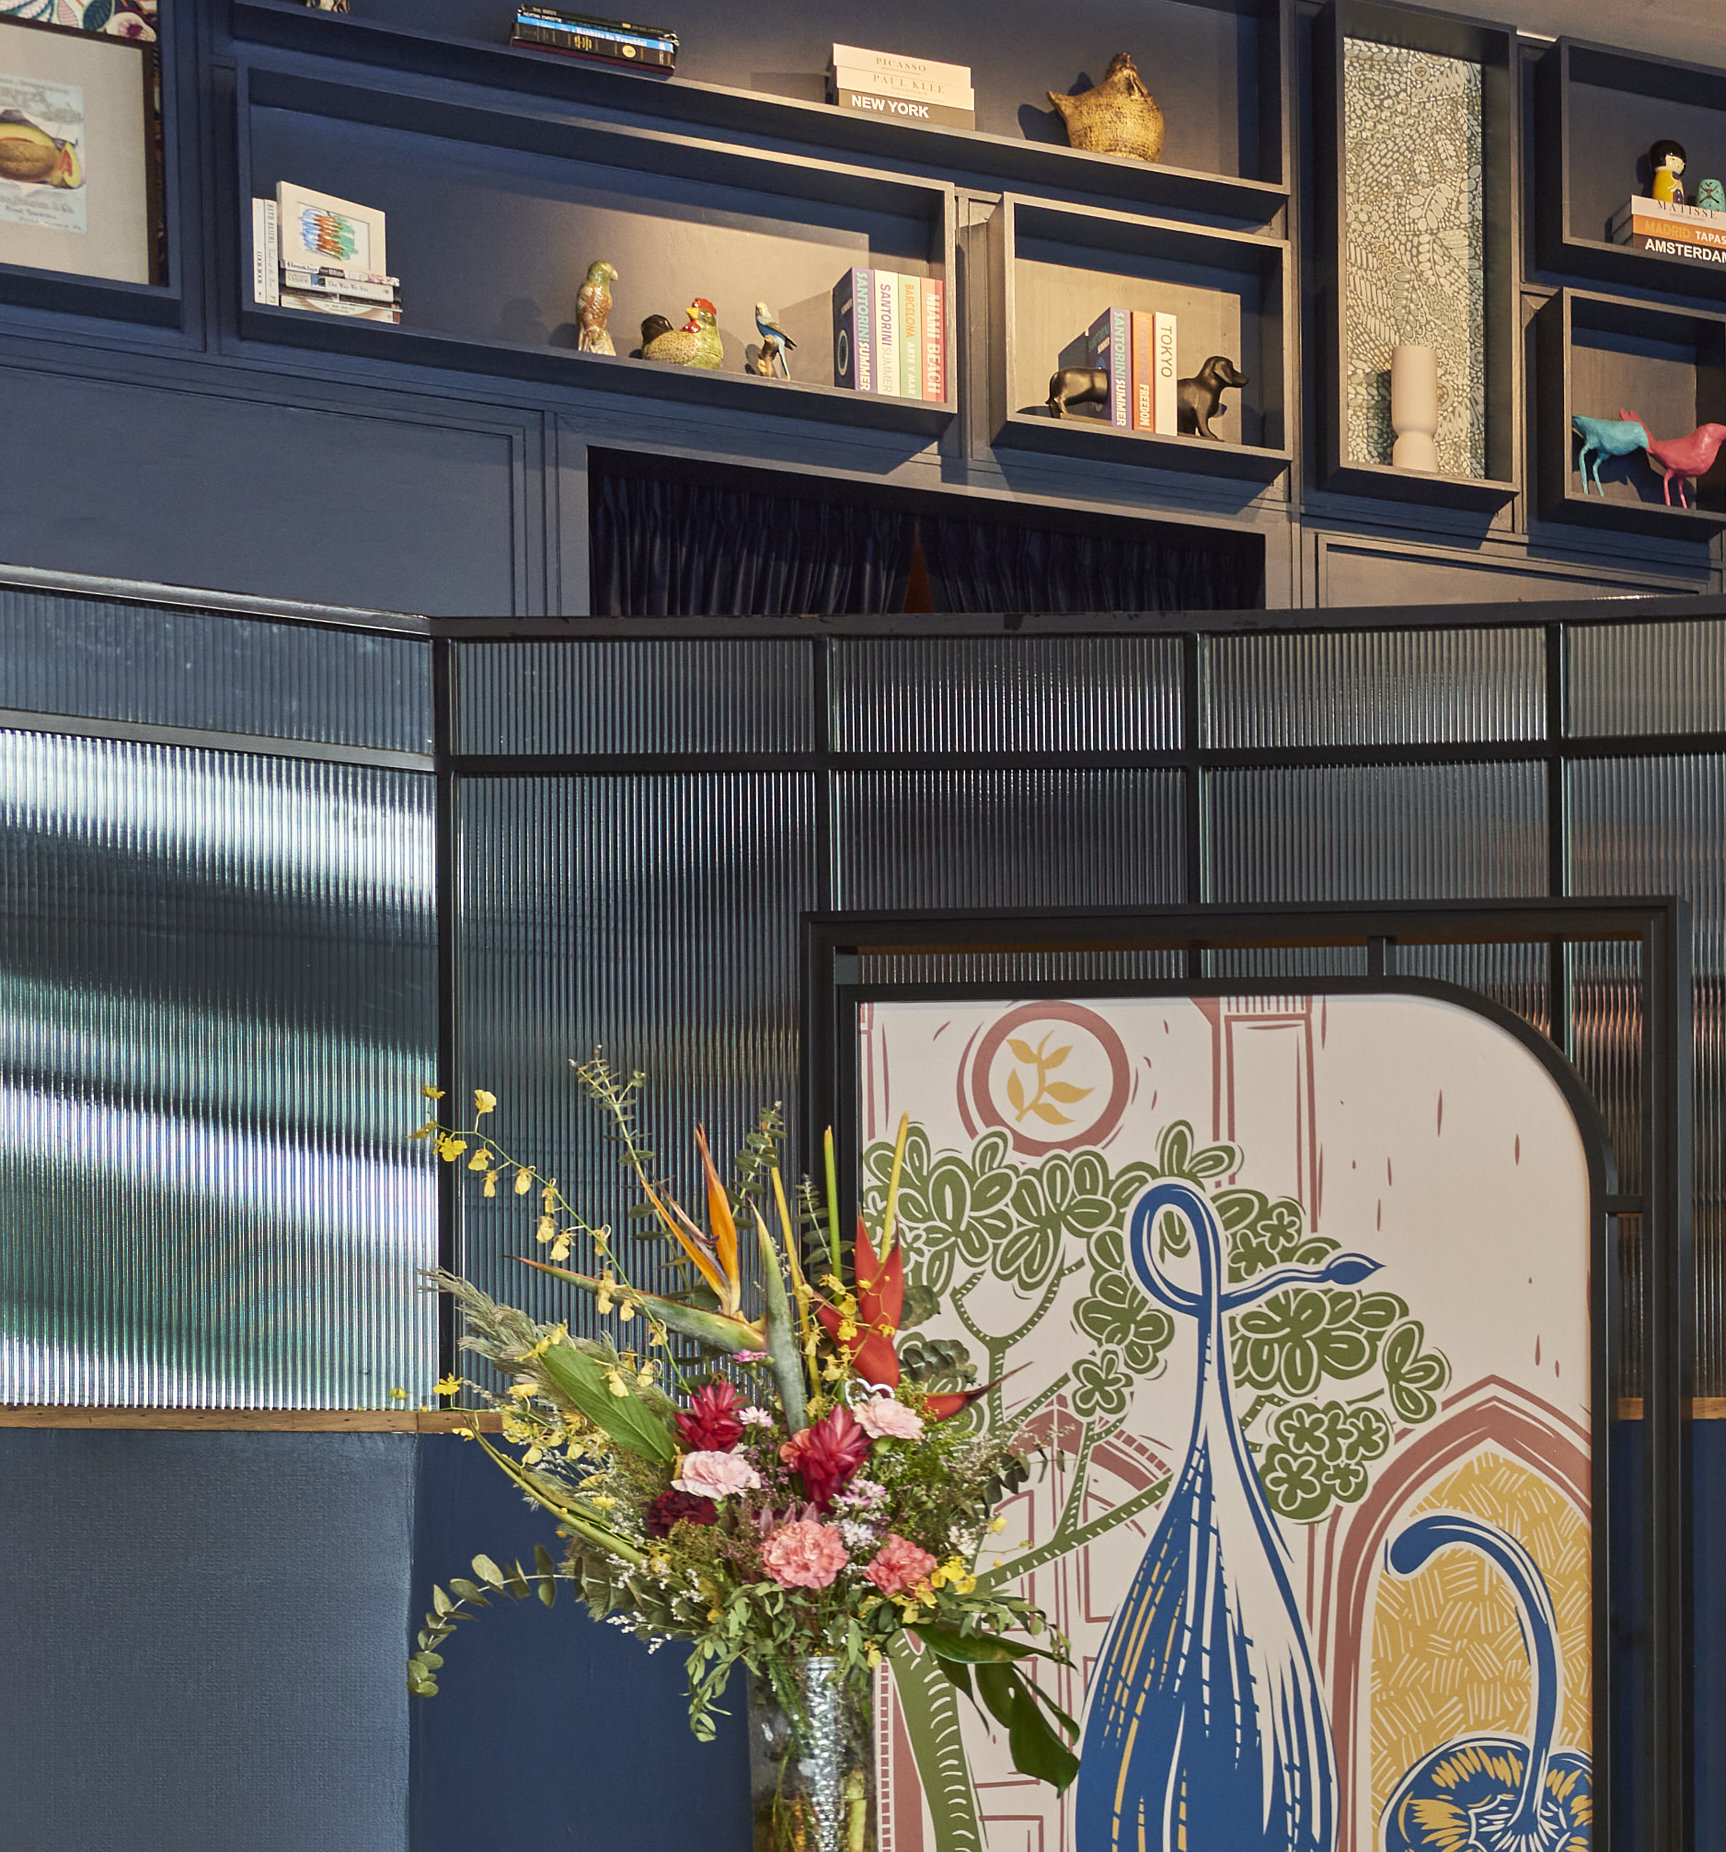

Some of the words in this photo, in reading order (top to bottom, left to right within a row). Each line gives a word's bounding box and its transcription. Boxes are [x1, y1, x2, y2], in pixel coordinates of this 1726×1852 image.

[873, 74, 904, 87] PAUL
[912, 82, 945, 94] KLEE
[876, 57, 927, 72] PICASSO
[851, 94, 885, 111] NEW
[887, 100, 930, 119] YORK
[1645, 221, 1691, 239] MADRID
[857, 271, 870, 342] SANTORINI
[880, 283, 892, 346] SANTORINI
[904, 283, 916, 338] BARCELONA
[926, 292, 941, 339] MIAMI
[858, 342, 871, 391] SUMMER
[906, 342, 916, 364] ARTE
[926, 343, 941, 394] BEACH
[1114, 311, 1126, 380] SANTORINI
[1160, 325, 1173, 378] TOKYO
[882, 346, 893, 393] SUMMER
[907, 376, 916, 395] MAR
[1115, 379, 1127, 427] SUMMER
[1139, 383, 1151, 426] FREEDOM
